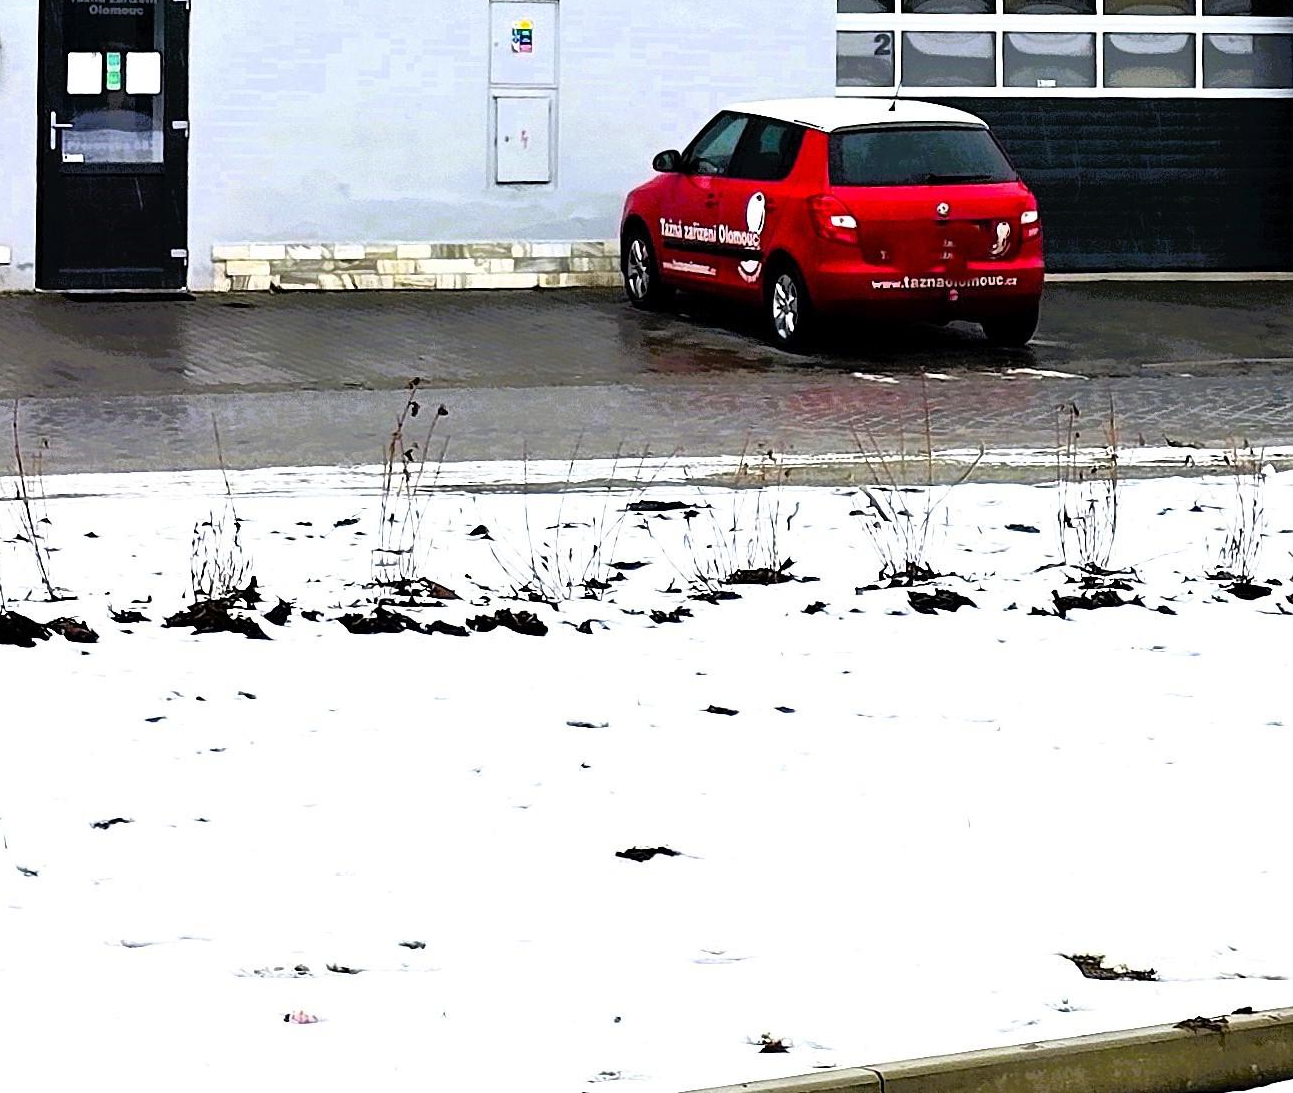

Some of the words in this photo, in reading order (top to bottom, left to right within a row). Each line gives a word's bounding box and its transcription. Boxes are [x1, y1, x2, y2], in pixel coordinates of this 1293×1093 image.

[88, 4, 145, 16] Olomouc
[873, 33, 891, 56] 2
[718, 223, 761, 247] Olomouc
